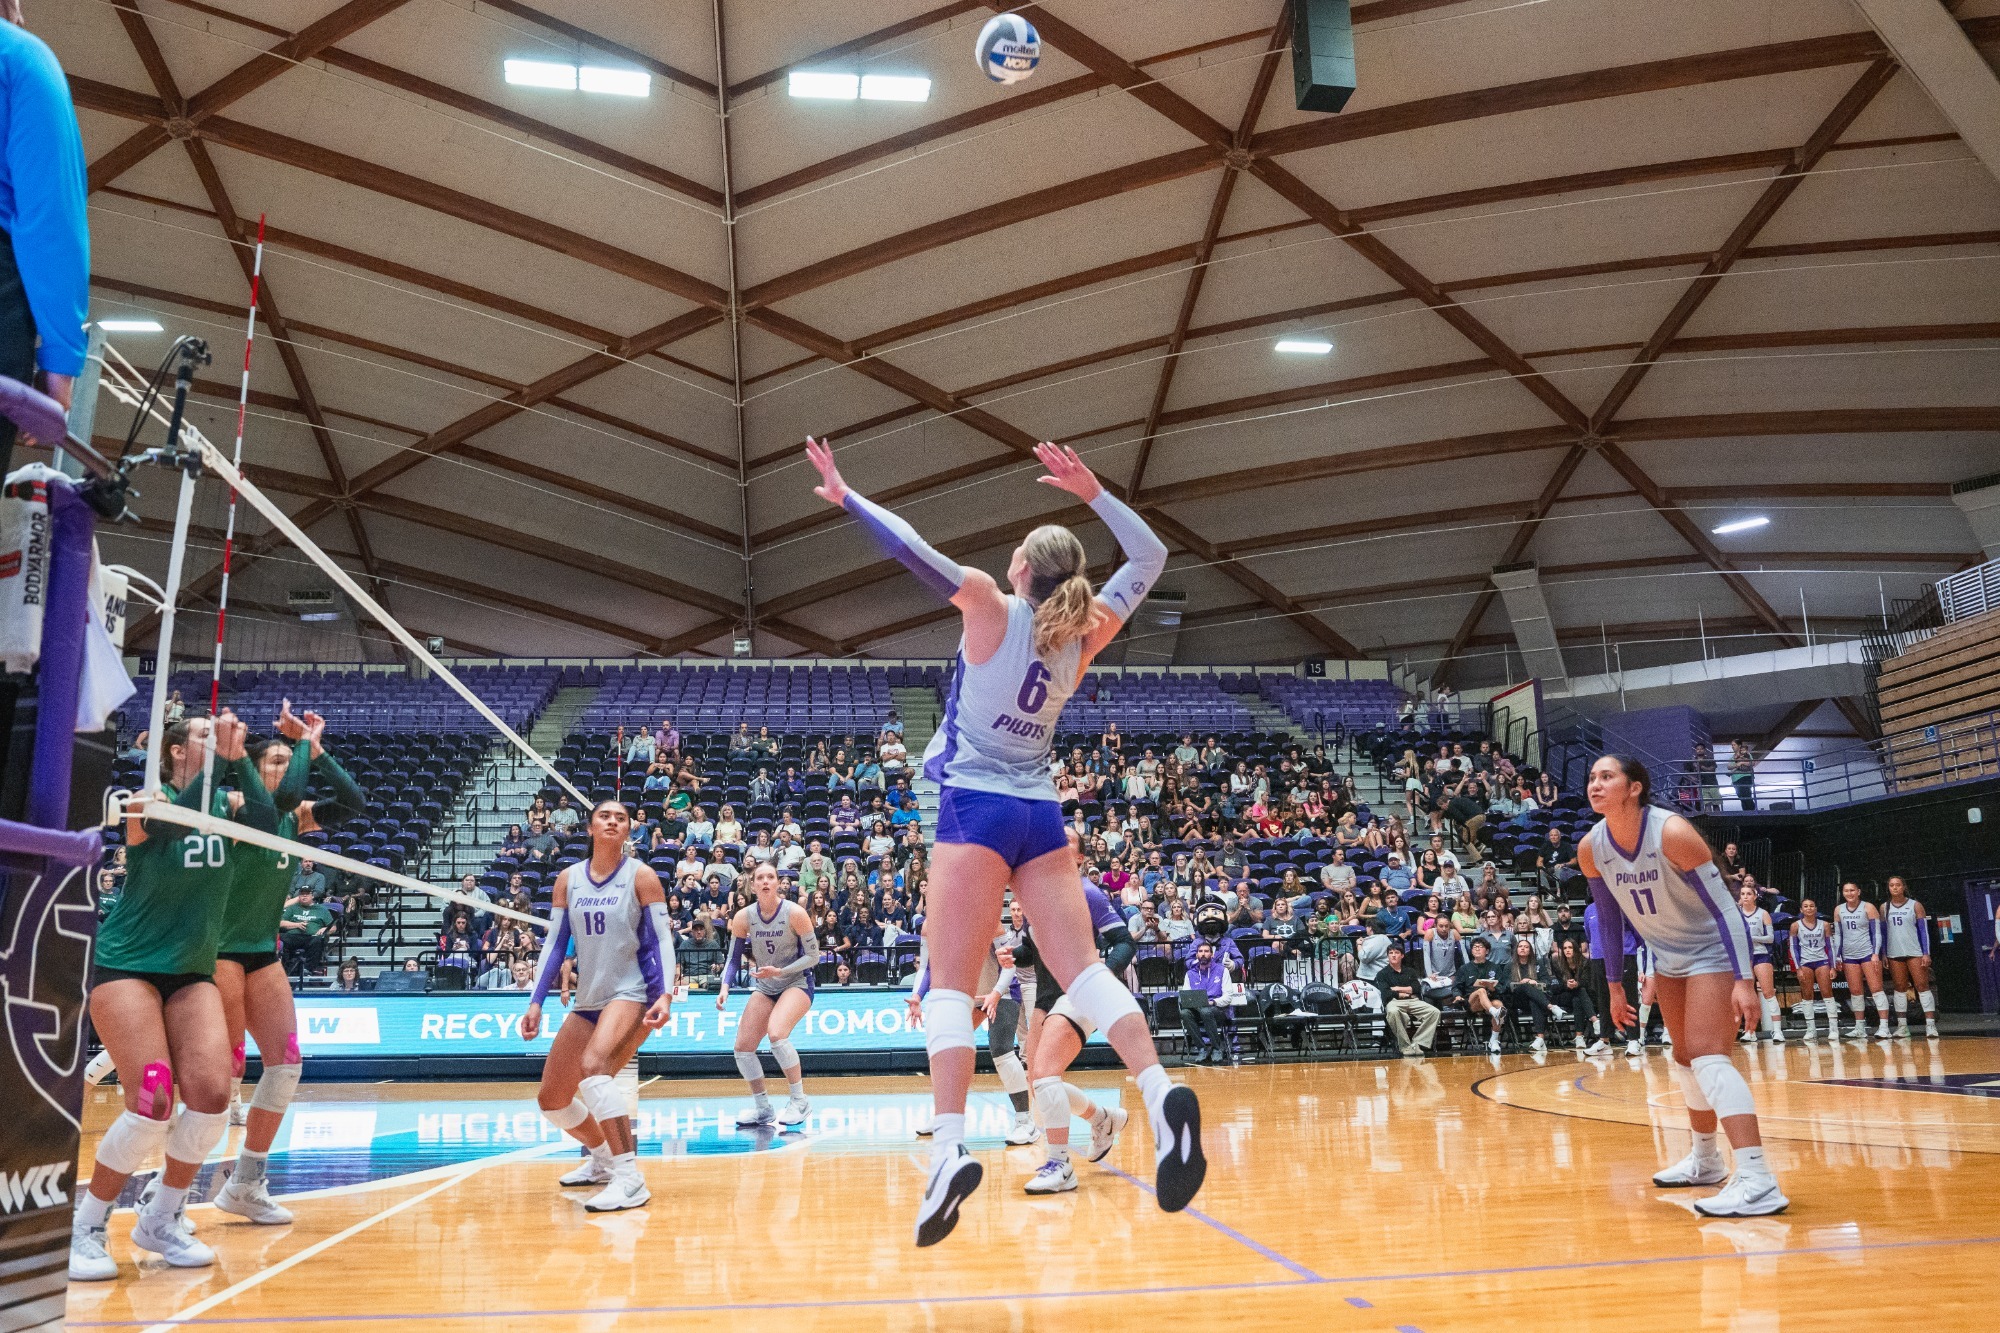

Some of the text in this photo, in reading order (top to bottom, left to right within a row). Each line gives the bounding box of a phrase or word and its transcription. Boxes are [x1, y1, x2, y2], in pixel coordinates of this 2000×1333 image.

[24, 512, 47, 606] BODYARMOR
[1310, 663, 1322, 674] 15
[1016, 660, 1052, 715] 6
[991, 713, 1048, 740] PILOTS
[184, 834, 225, 868] 20
[575, 897, 619, 909] PORTLAND
[1629, 887, 1658, 916] 17
[583, 911, 606, 936] 18
[1846, 920, 1857, 930] 16
[1892, 916, 1903, 926] 15
[765, 940, 776, 955] 5
[1808, 939, 1819, 948] 12
[421, 1013, 567, 1039] RECYL
[0, 1160, 71, 1214] WCC
